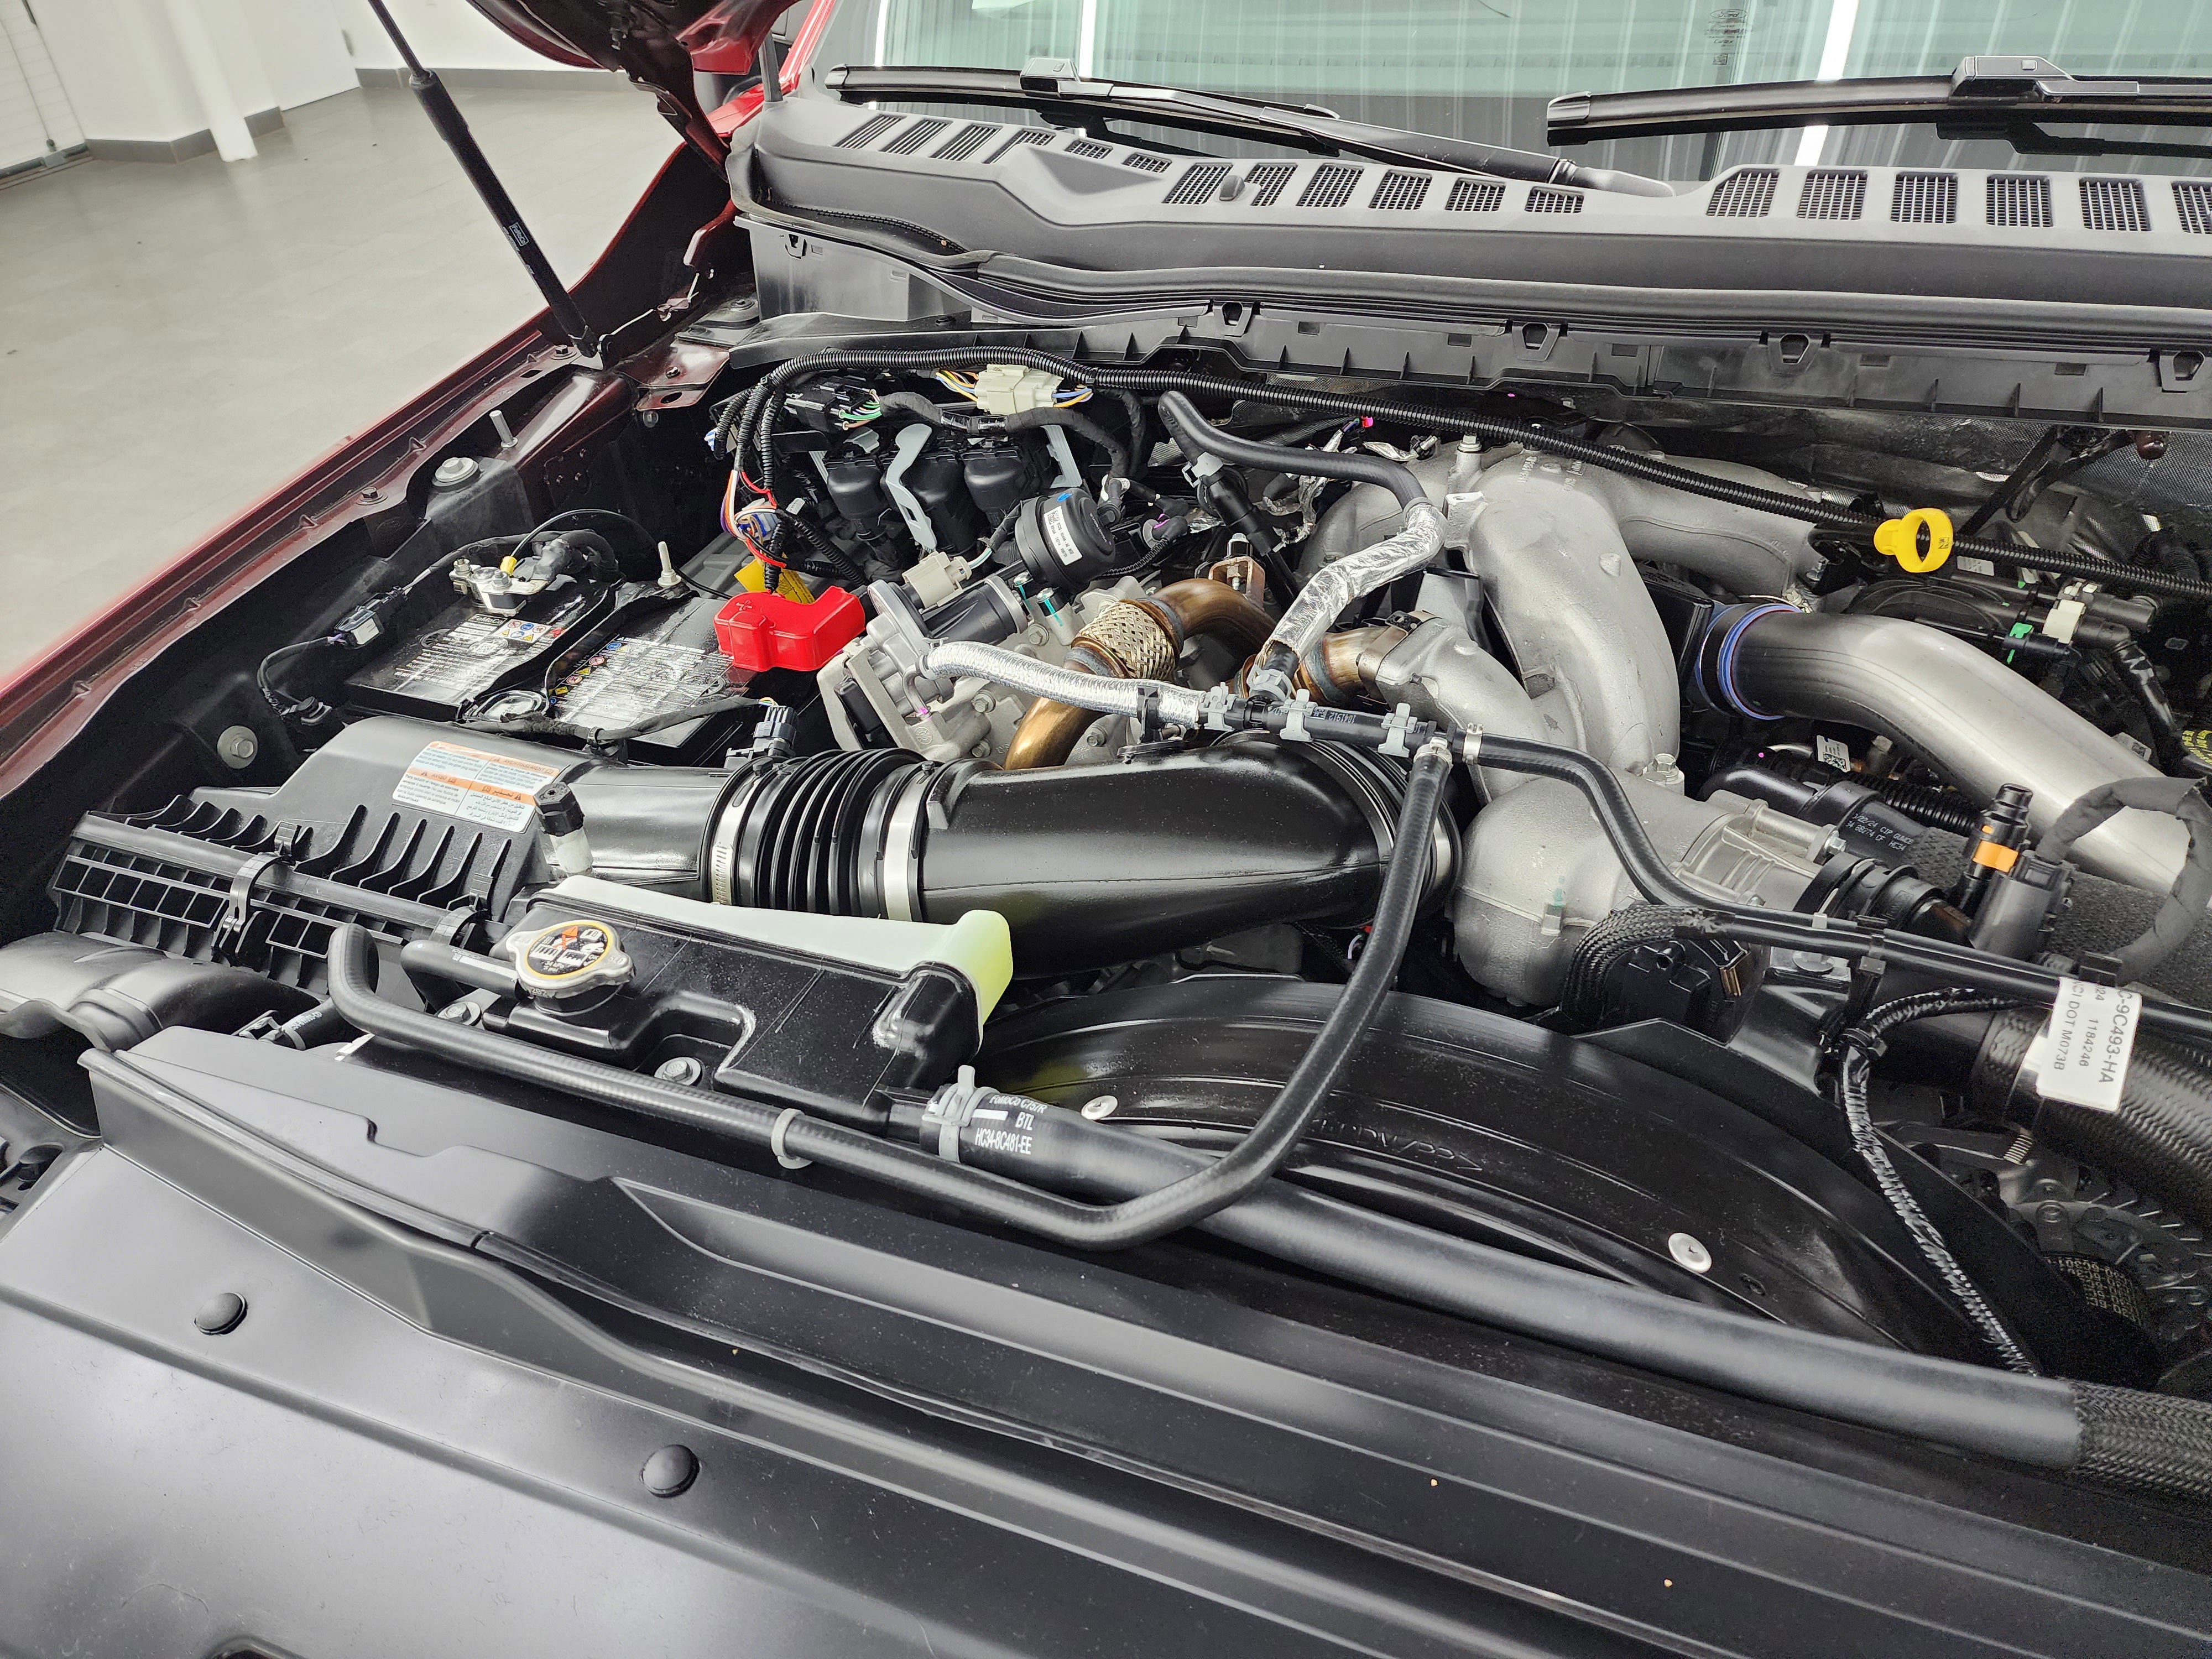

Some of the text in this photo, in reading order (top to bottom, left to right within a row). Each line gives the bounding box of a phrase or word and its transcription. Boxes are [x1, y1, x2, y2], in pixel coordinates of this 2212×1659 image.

[473, 615, 504, 625] FoMoCo
[2066, 1001, 2080, 1026] DOT
[2054, 1030, 2072, 1071] M073B
[2079, 1019, 2099, 1067] 1184246
[989, 1094, 1048, 1114] FoMoCo C757R
[1015, 1112, 1035, 1131] BTL
[975, 1128, 1032, 1155] HC34-8C481-EE
